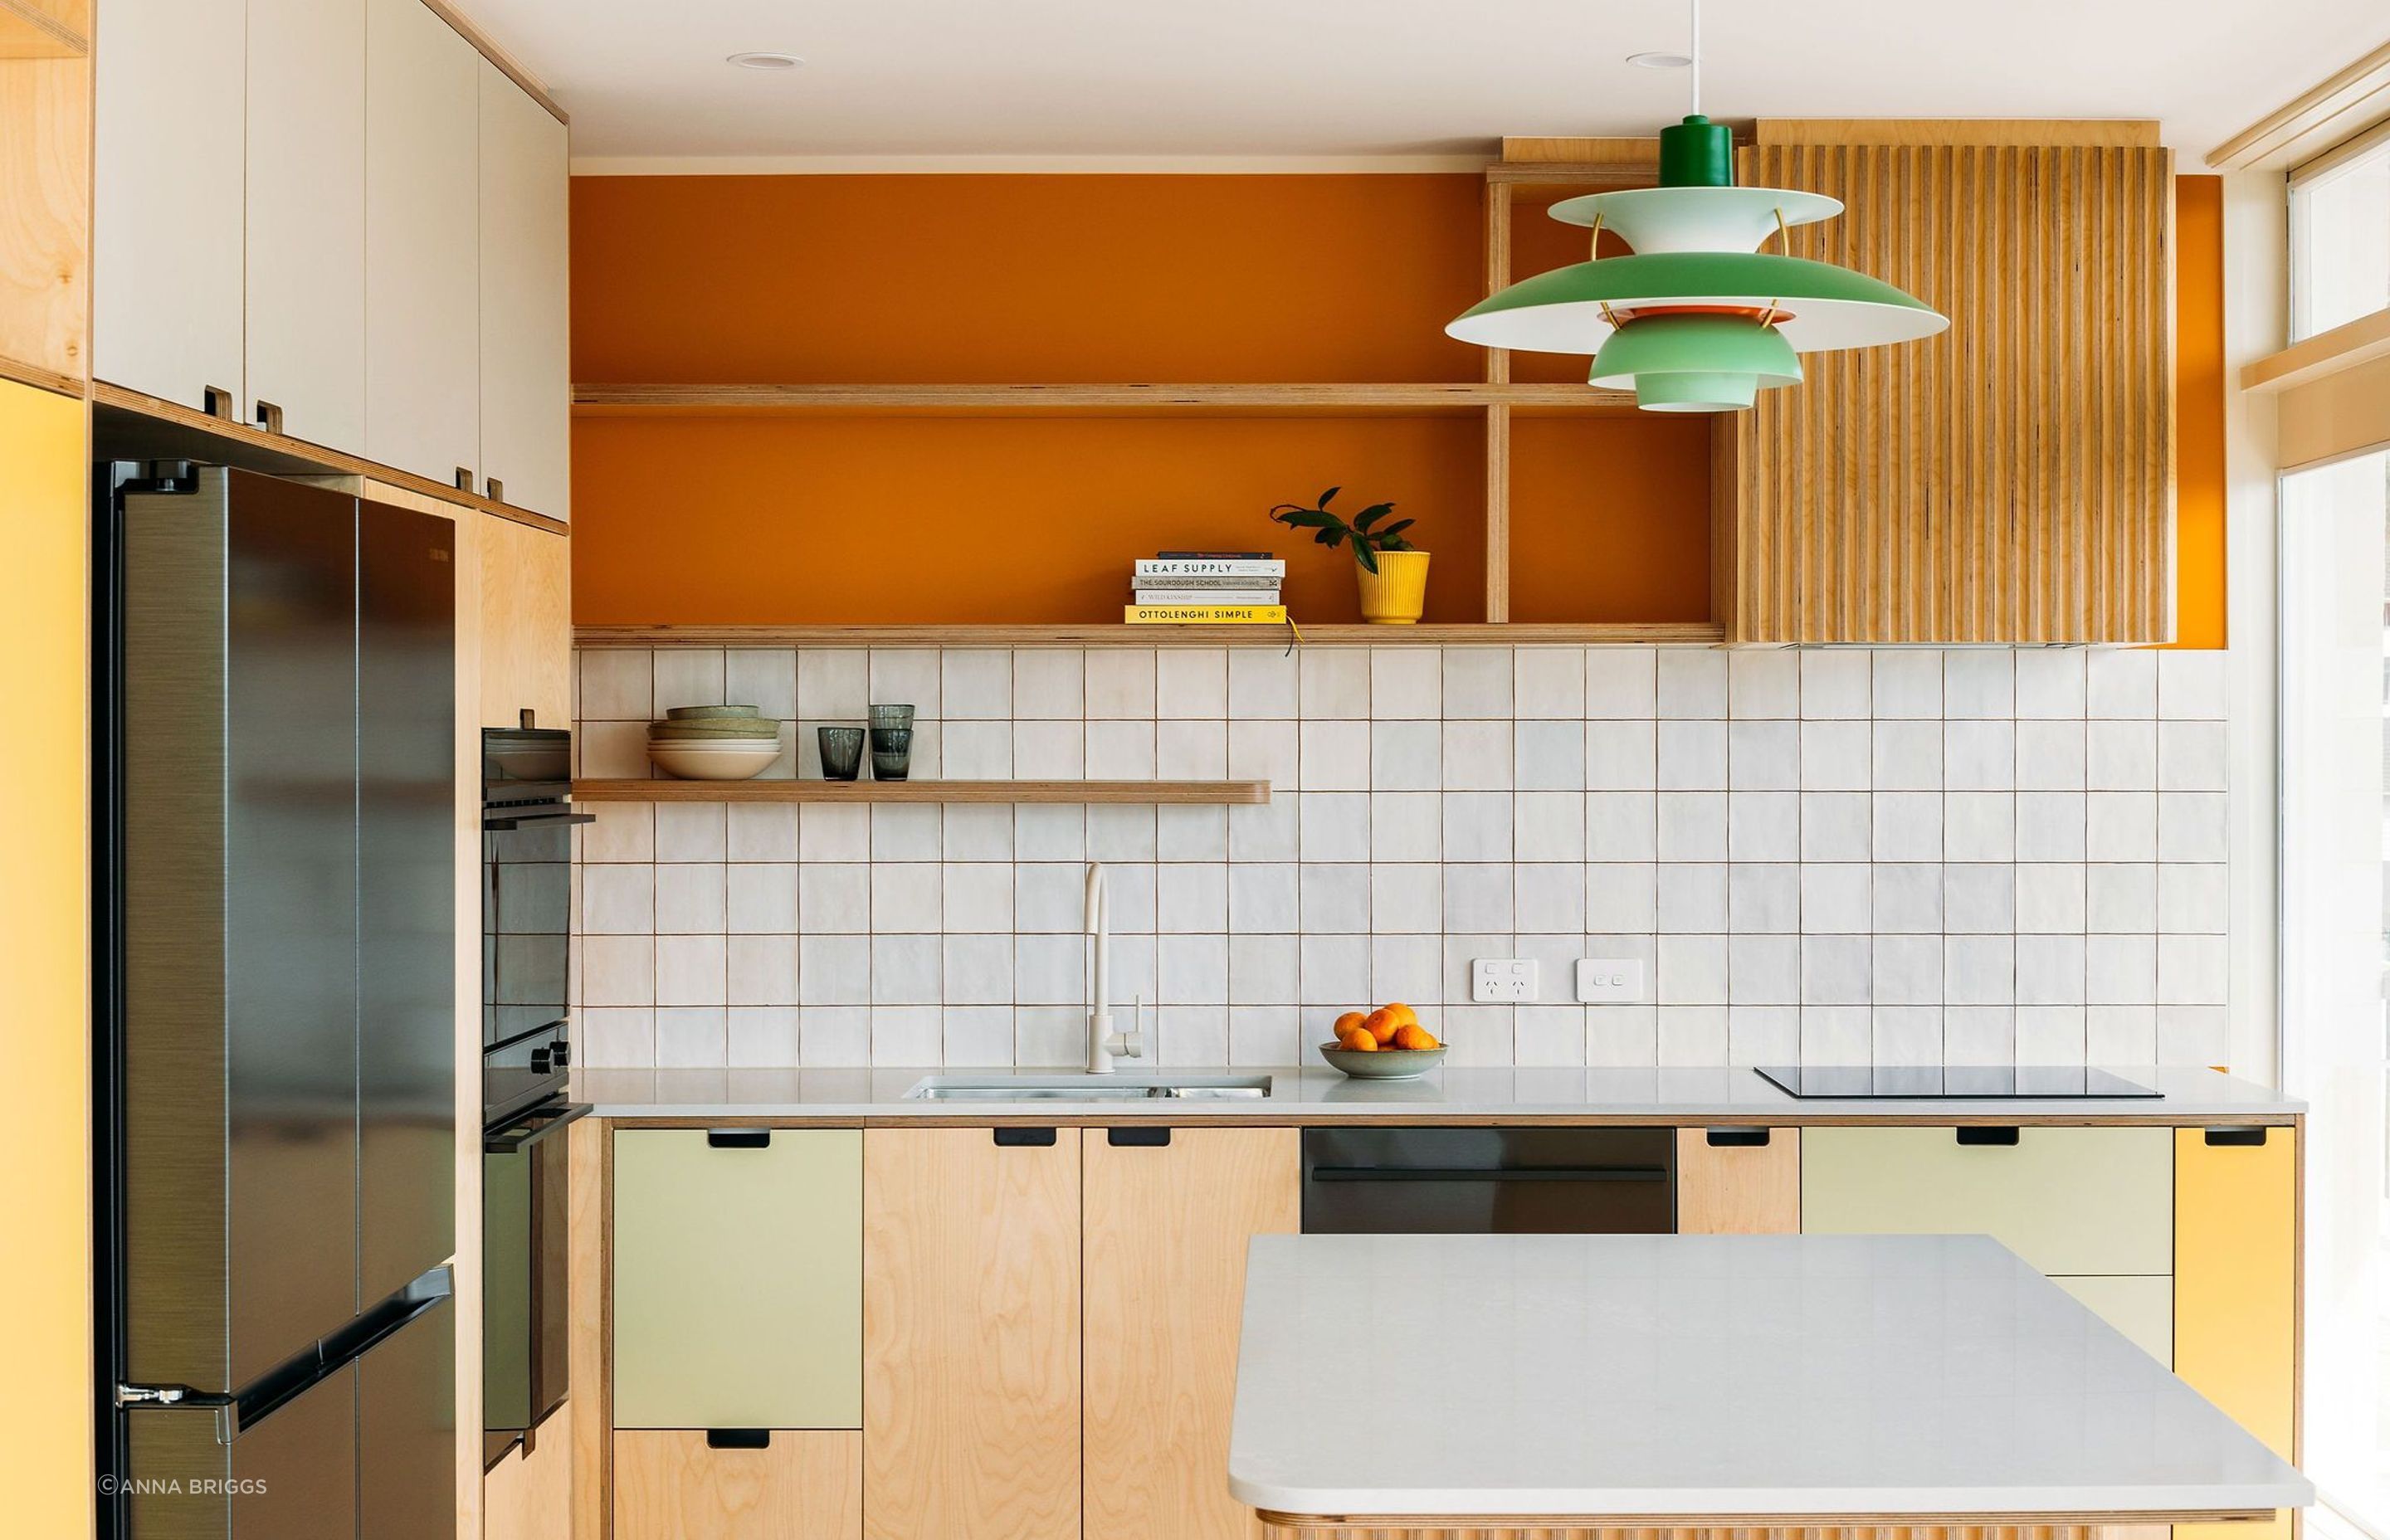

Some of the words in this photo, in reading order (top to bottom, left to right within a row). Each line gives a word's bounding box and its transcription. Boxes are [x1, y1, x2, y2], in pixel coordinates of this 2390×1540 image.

[1144, 564, 1178, 573] LEAF
[1183, 564, 1232, 573] SUPPLY
[1139, 610, 1209, 619] OTTOLENGHI
[1214, 610, 1253, 619] SIMPLE
